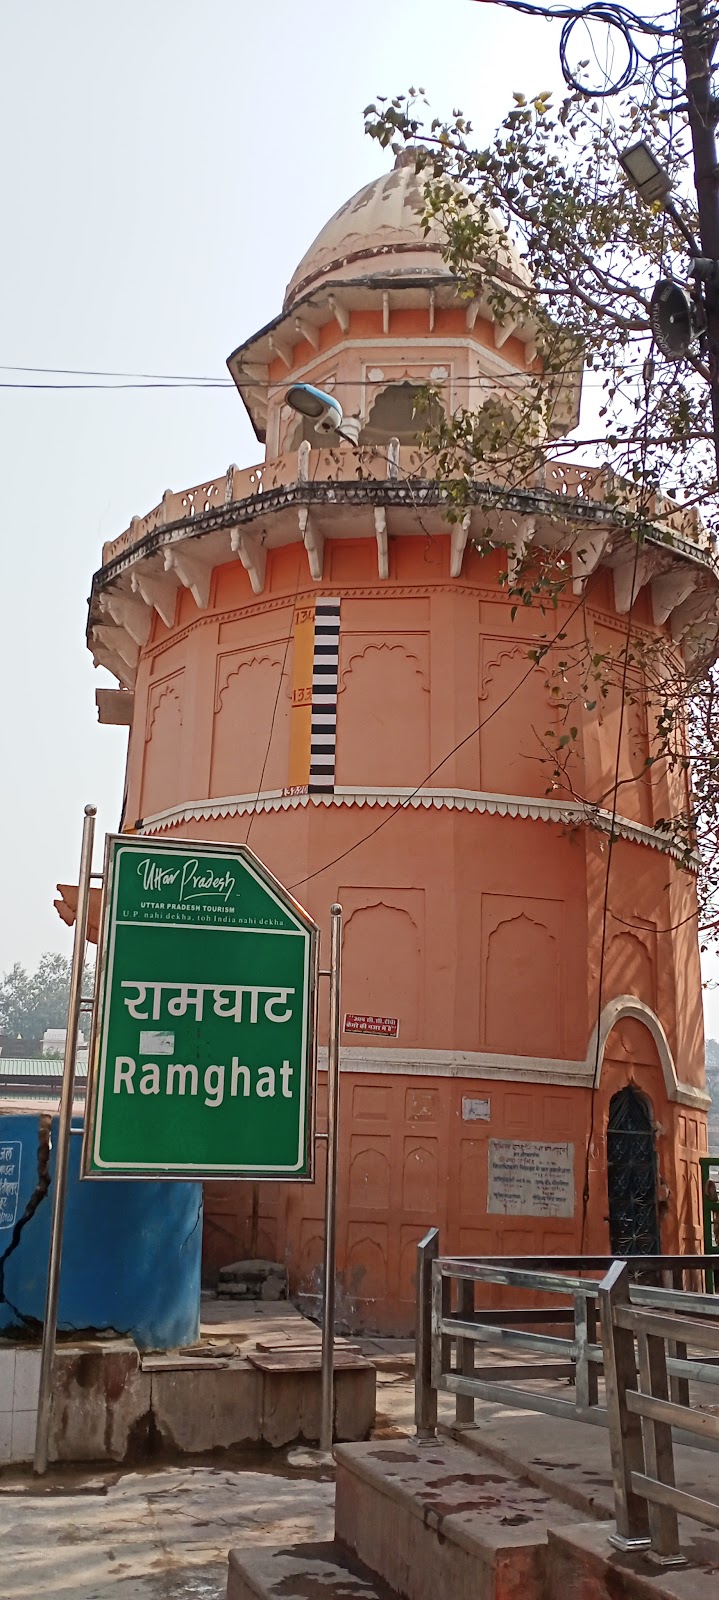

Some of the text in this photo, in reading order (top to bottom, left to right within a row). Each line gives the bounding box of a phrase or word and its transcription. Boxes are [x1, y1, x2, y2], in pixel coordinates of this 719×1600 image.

[295, 610, 315, 625] 134
[293, 687, 312, 702] 133
[137, 859, 236, 902] Uttar Pradesh
[140, 902, 235, 914] UTTAR PRADESH TOURISM
[122, 910, 141, 918] U.P.
[144, 911, 163, 919] nahi
[197, 914, 211, 922] toh
[214, 914, 236, 923] India
[238, 916, 257, 924] nahi
[121, 980, 296, 1024] रामघाट
[113, 1056, 294, 1107] Ramghat
